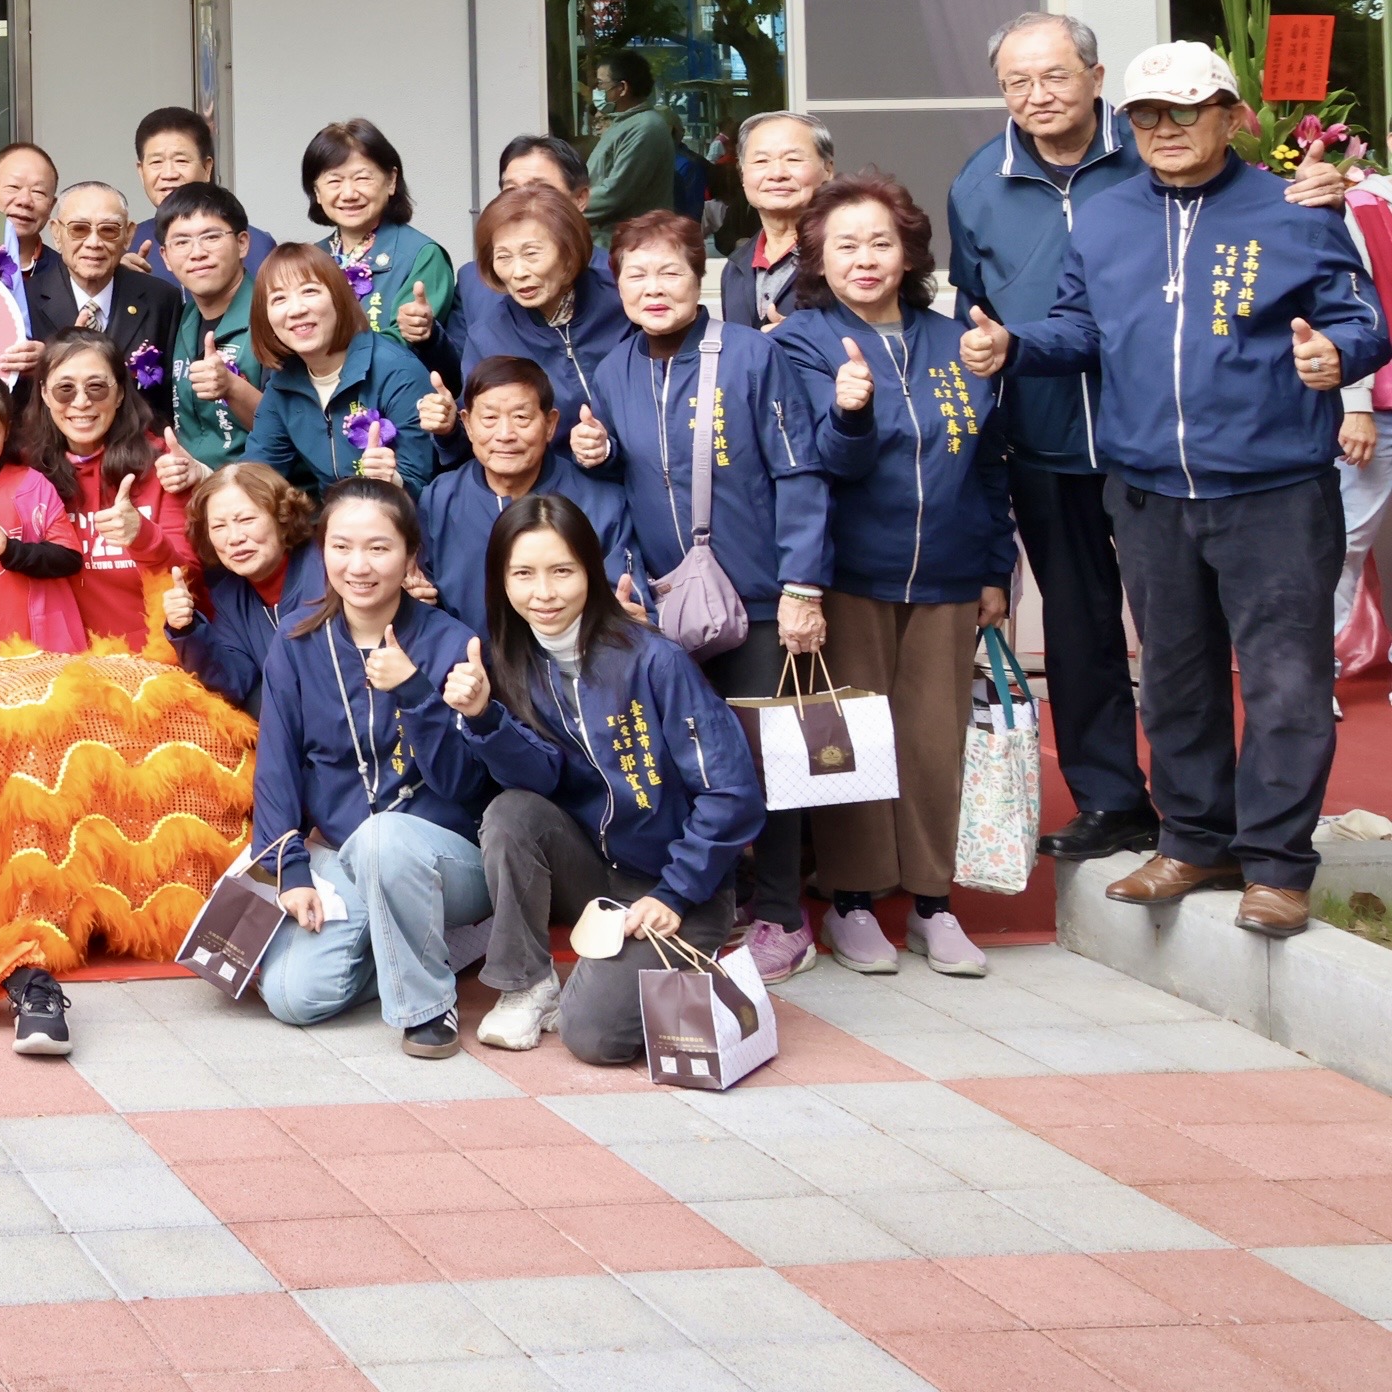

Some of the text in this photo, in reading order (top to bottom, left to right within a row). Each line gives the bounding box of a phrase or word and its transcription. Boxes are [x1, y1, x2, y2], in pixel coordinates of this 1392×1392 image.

[1237, 239, 1262, 317] 臺南市北區
[948, 361, 979, 435] 臺南市北區
[630, 699, 662, 786] 臺南市北區
